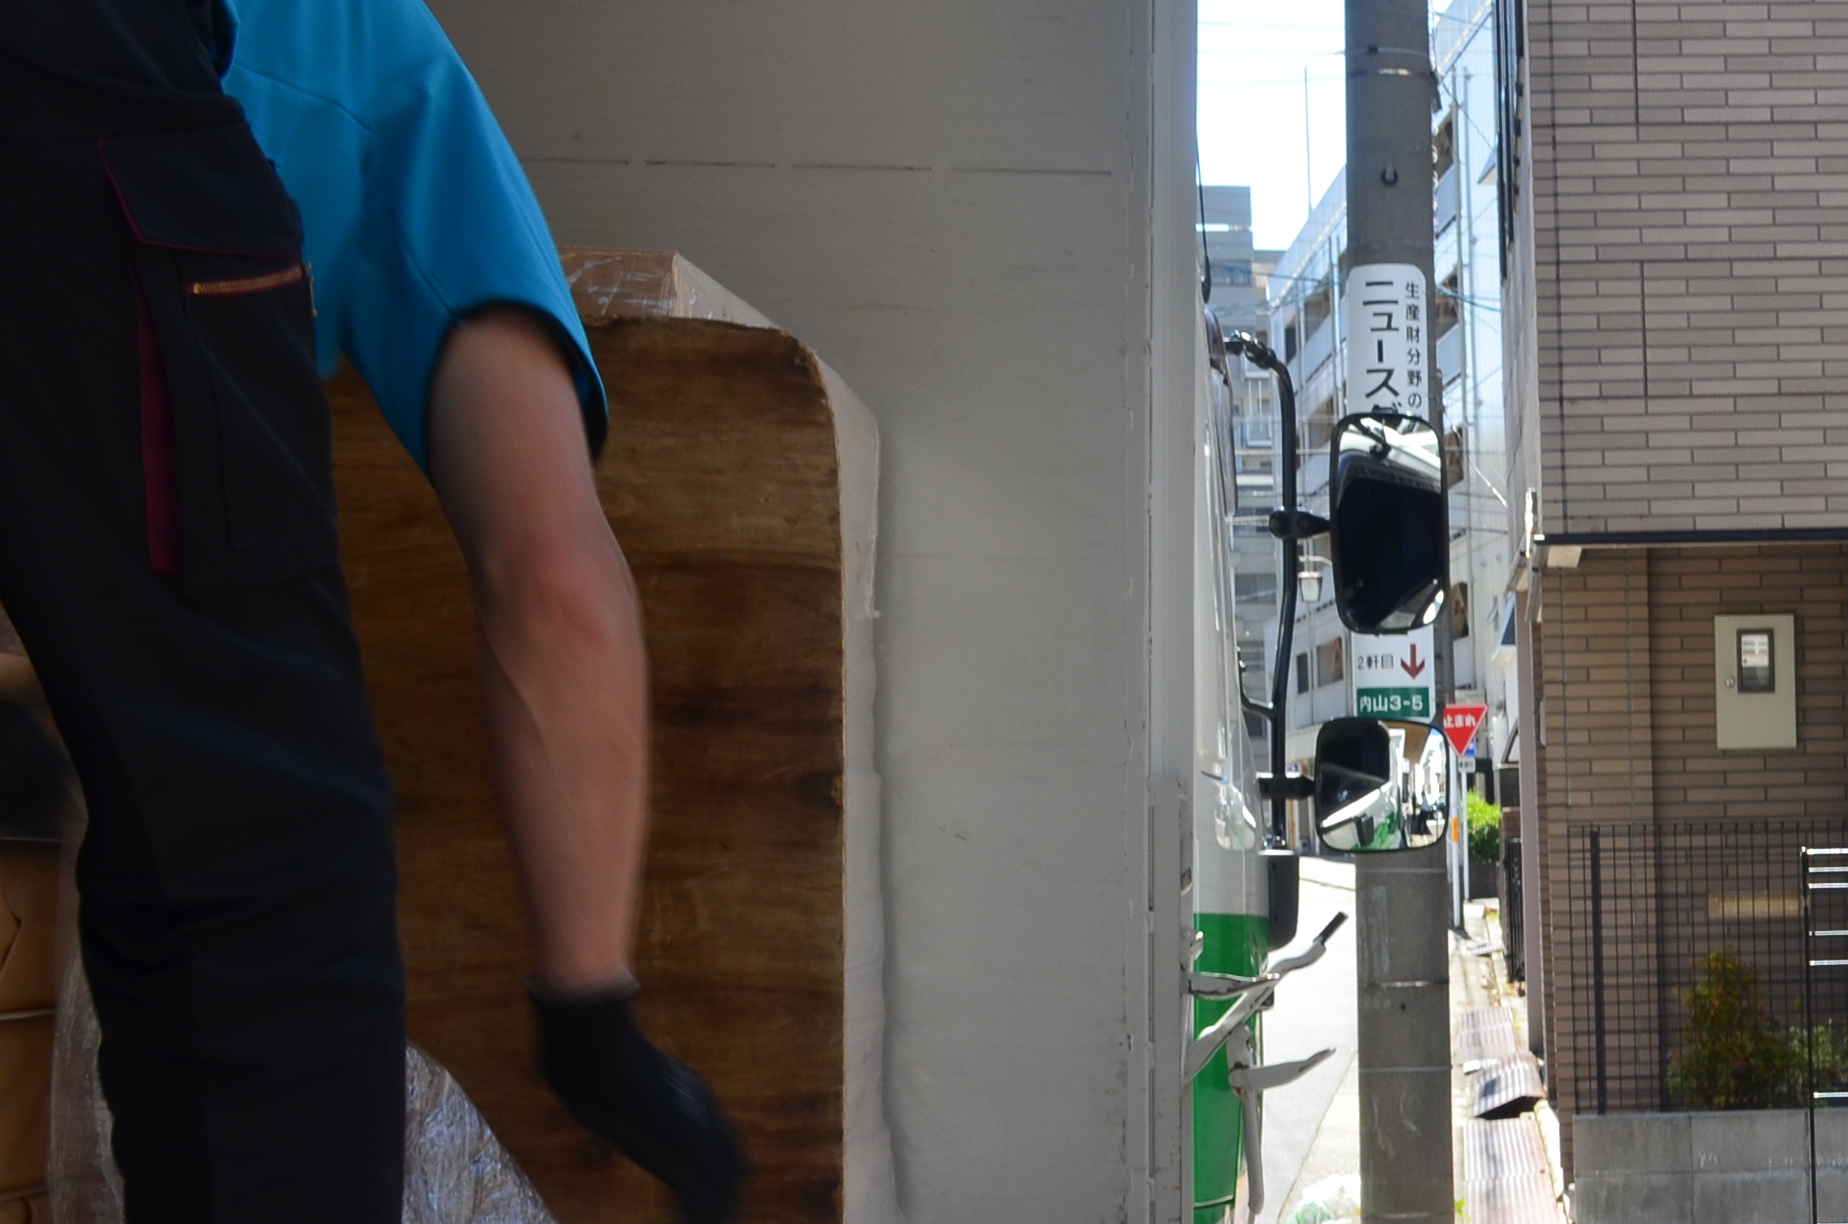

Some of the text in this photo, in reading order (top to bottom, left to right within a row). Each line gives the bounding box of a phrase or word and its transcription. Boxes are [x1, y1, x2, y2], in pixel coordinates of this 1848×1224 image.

[1404, 281, 1423, 418] 生産財分野の
[1357, 652, 1394, 670] 2軒目
[1359, 694, 1423, 713] 内山3-5
[1443, 712, 1476, 729] 止まれ
